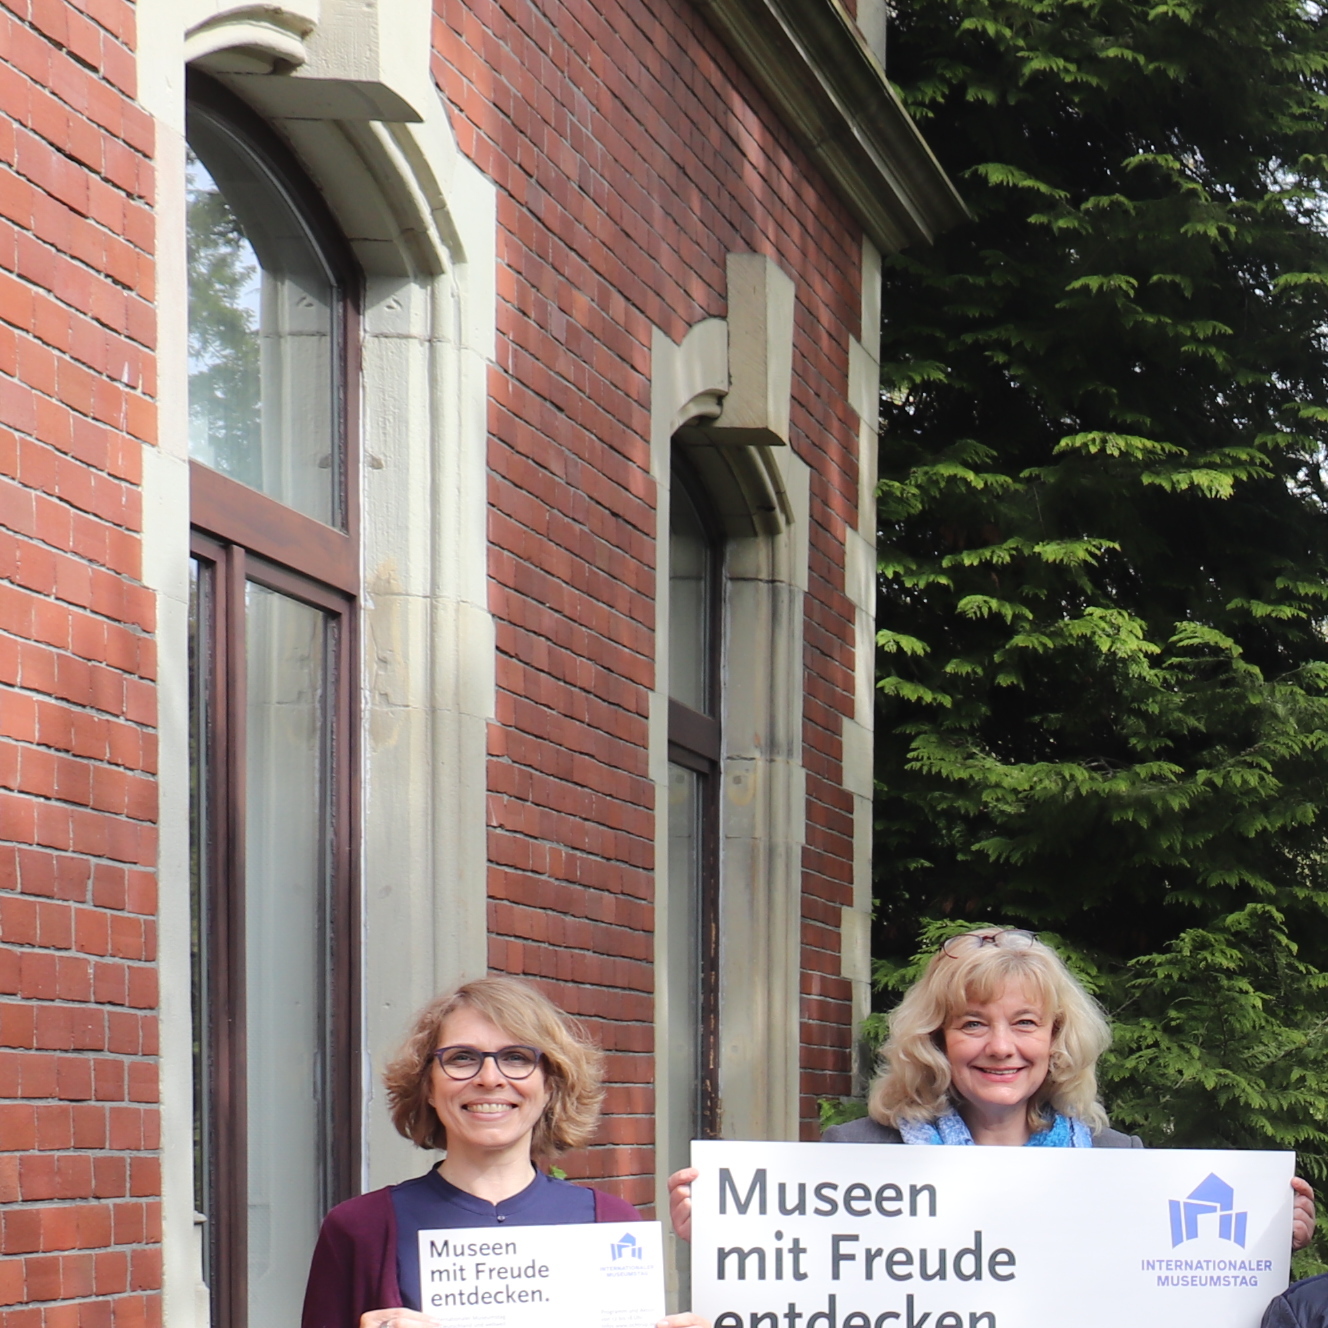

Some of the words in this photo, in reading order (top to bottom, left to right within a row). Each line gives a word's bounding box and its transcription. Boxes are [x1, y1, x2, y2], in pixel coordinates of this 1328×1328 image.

[719, 1168, 936, 1217] Museen
[430, 1240, 516, 1258] Museen
[717, 1230, 808, 1281] mit
[832, 1230, 1016, 1281] Freude
[431, 1263, 466, 1282] mit
[475, 1259, 549, 1280] Freude
[1142, 1260, 1272, 1271] INTERNATIONALER
[1158, 1276, 1257, 1286] MUSEUMSTAG
[431, 1284, 549, 1306] entdecken.
